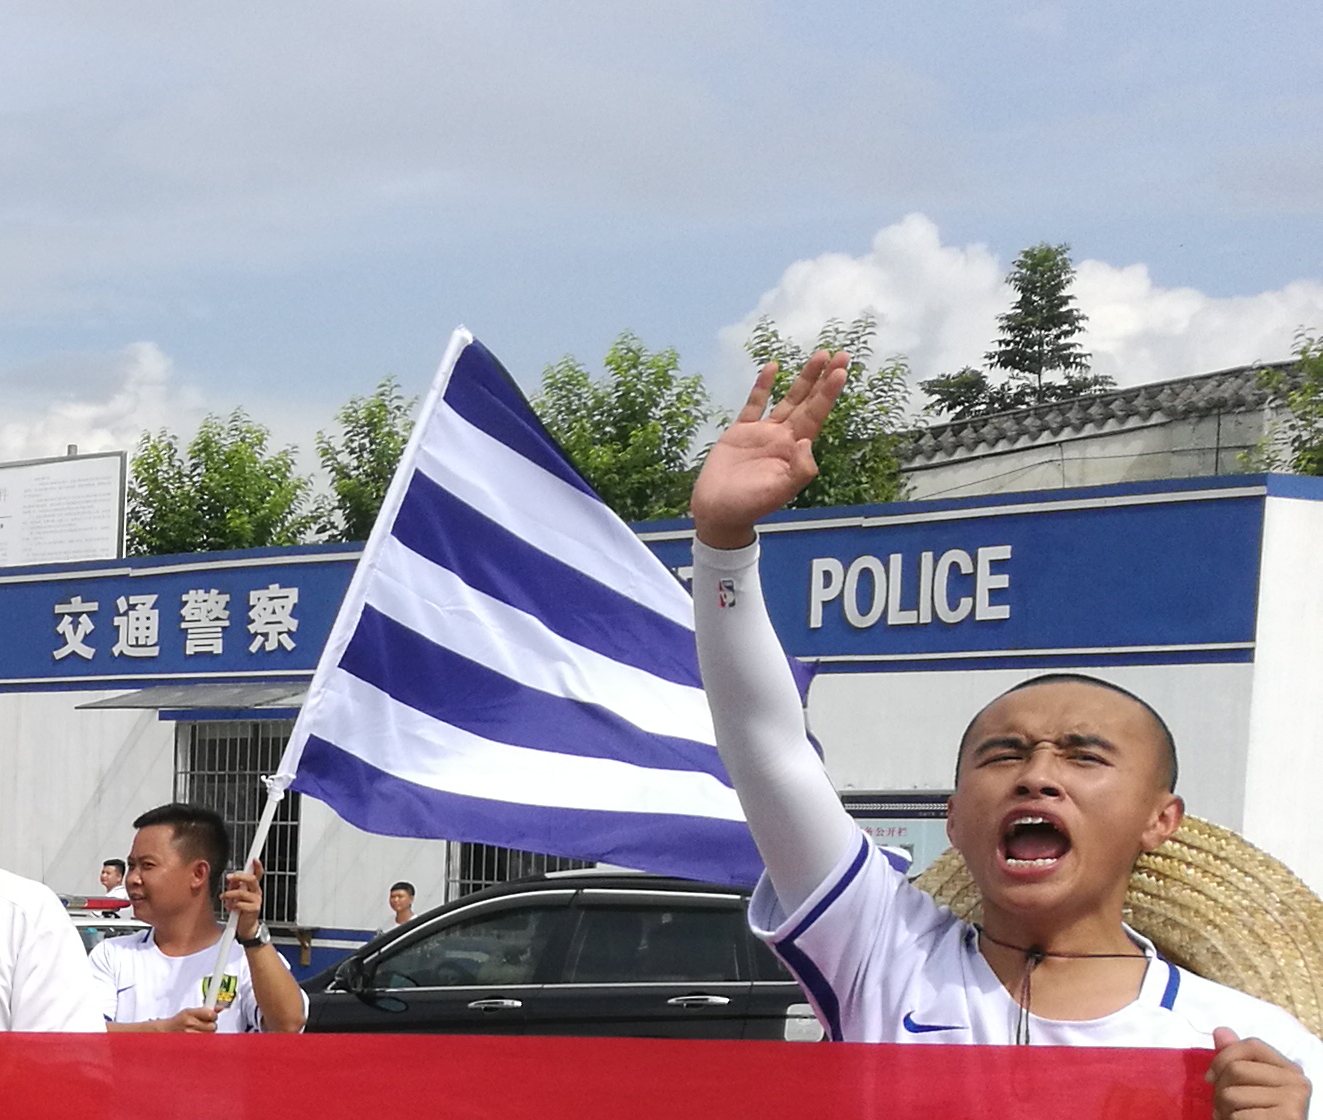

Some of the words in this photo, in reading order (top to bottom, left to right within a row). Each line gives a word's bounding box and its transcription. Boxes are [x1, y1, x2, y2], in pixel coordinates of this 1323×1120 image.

[52, 583, 300, 660] 交通警察
[810, 545, 1012, 629] POLICE
